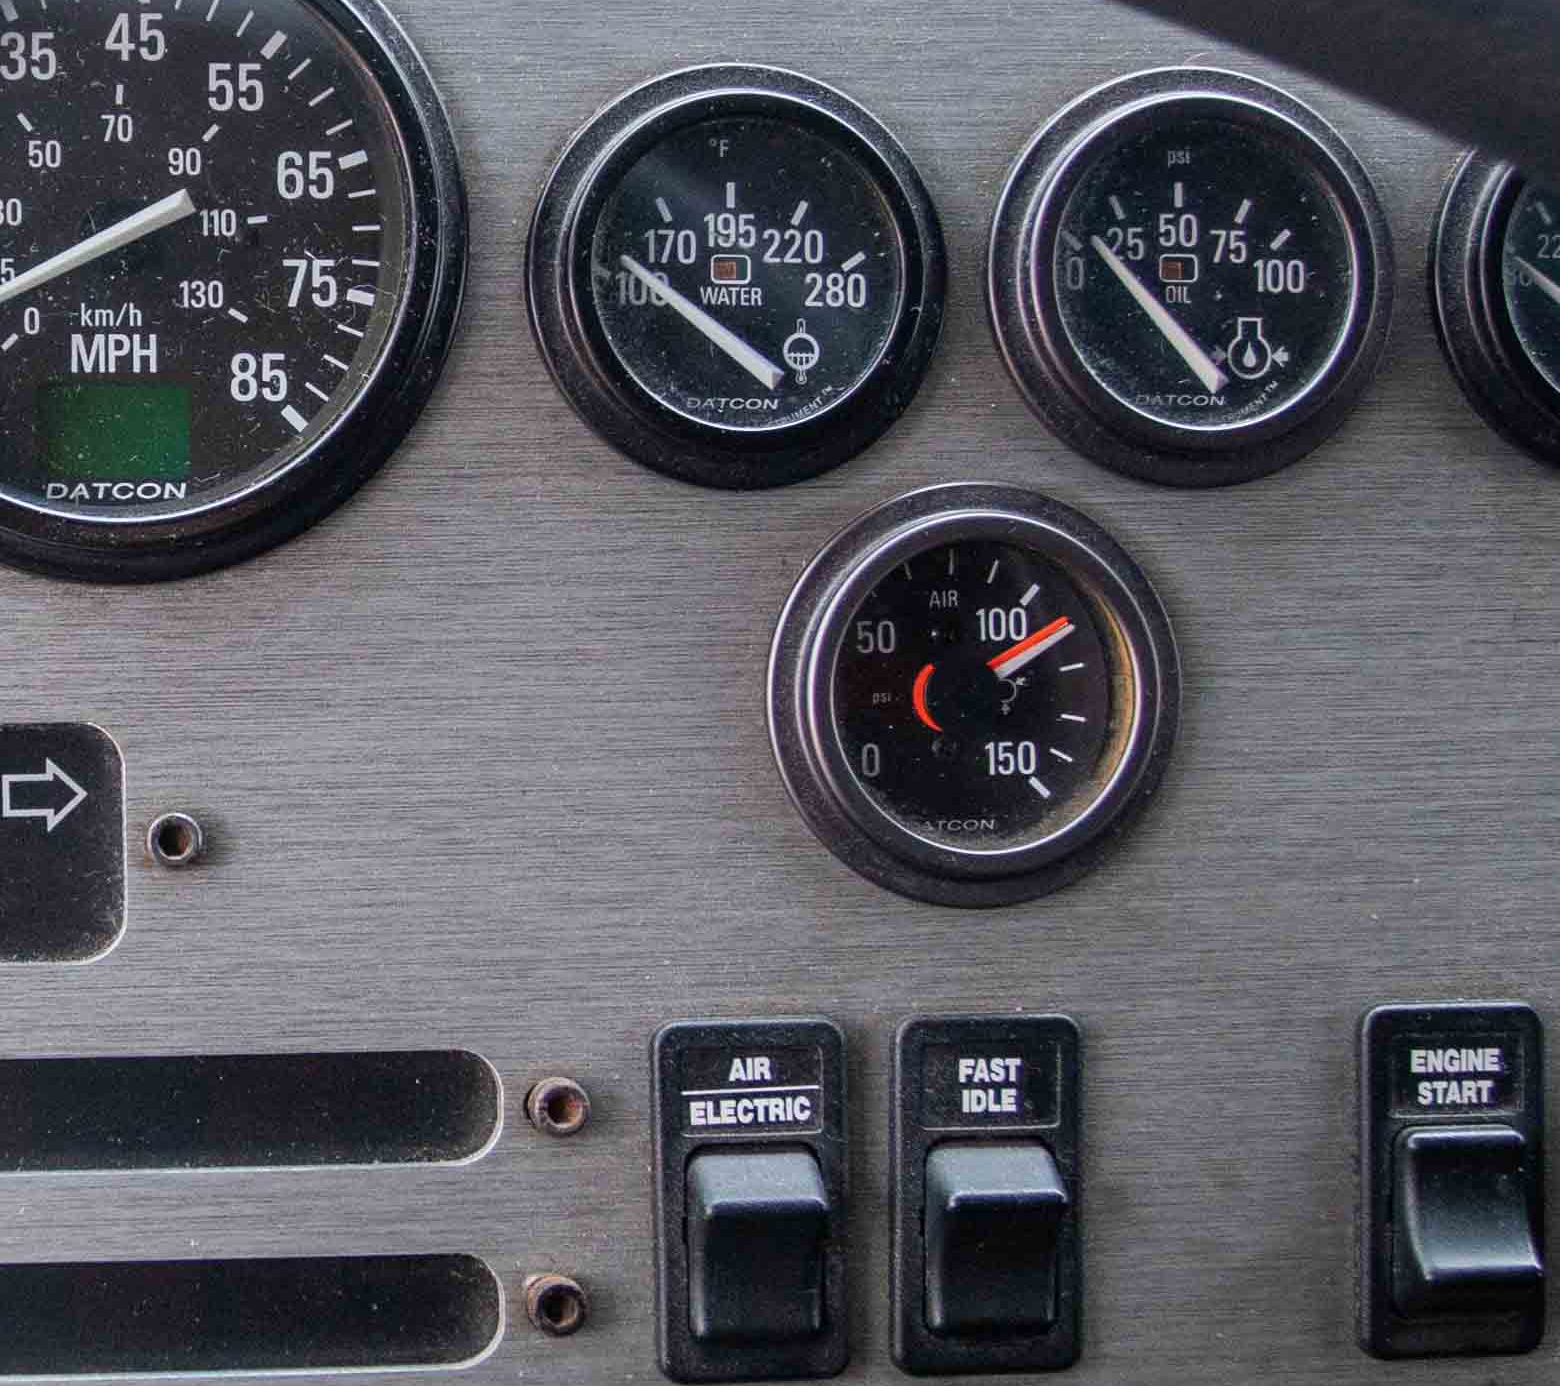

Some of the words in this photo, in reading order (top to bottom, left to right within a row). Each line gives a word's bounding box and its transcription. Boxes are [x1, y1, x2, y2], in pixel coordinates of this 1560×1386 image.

[105, 13, 166, 62] 45
[0, 32, 57, 81] 35
[207, 63, 264, 112] 55
[101, 115, 133, 142] 70
[27, 141, 62, 168] 50
[168, 148, 201, 175] 90
[1167, 148, 1191, 167] psi
[276, 151, 334, 199] 65
[199, 209, 236, 238] 110
[704, 214, 756, 248] 195
[1159, 214, 1198, 248] 50
[644, 229, 696, 264] 170
[762, 228, 823, 264] 220
[1107, 228, 1144, 261] 25
[1210, 230, 1247, 264] 75
[282, 259, 337, 307] 75
[1066, 258, 1084, 291] 0
[1253, 260, 1305, 295] 100
[179, 280, 223, 309] 130
[699, 287, 762, 307] WATER
[804, 273, 867, 307] 280
[1165, 285, 1192, 305] OIL
[24, 307, 40, 337] 0
[80, 303, 142, 329] km/h
[70, 334, 157, 374] MPH
[229, 352, 287, 401] 85
[687, 397, 779, 411] DATCON
[1135, 394, 1225, 406] DATCON
[45, 482, 186, 501] DATCON
[929, 590, 959, 608] AIR
[855, 620, 896, 654] 50
[976, 608, 1027, 642] 100
[872, 691, 891, 705] psi
[861, 744, 880, 778] 0
[984, 741, 1036, 775] 150
[728, 1056, 771, 1082] AIR
[959, 1057, 1021, 1083] FAST
[1410, 1048, 1501, 1074] ENGINE
[962, 1088, 1017, 1113] IDLE
[1417, 1080, 1495, 1105] START
[689, 1096, 811, 1126] ELECTRIC
